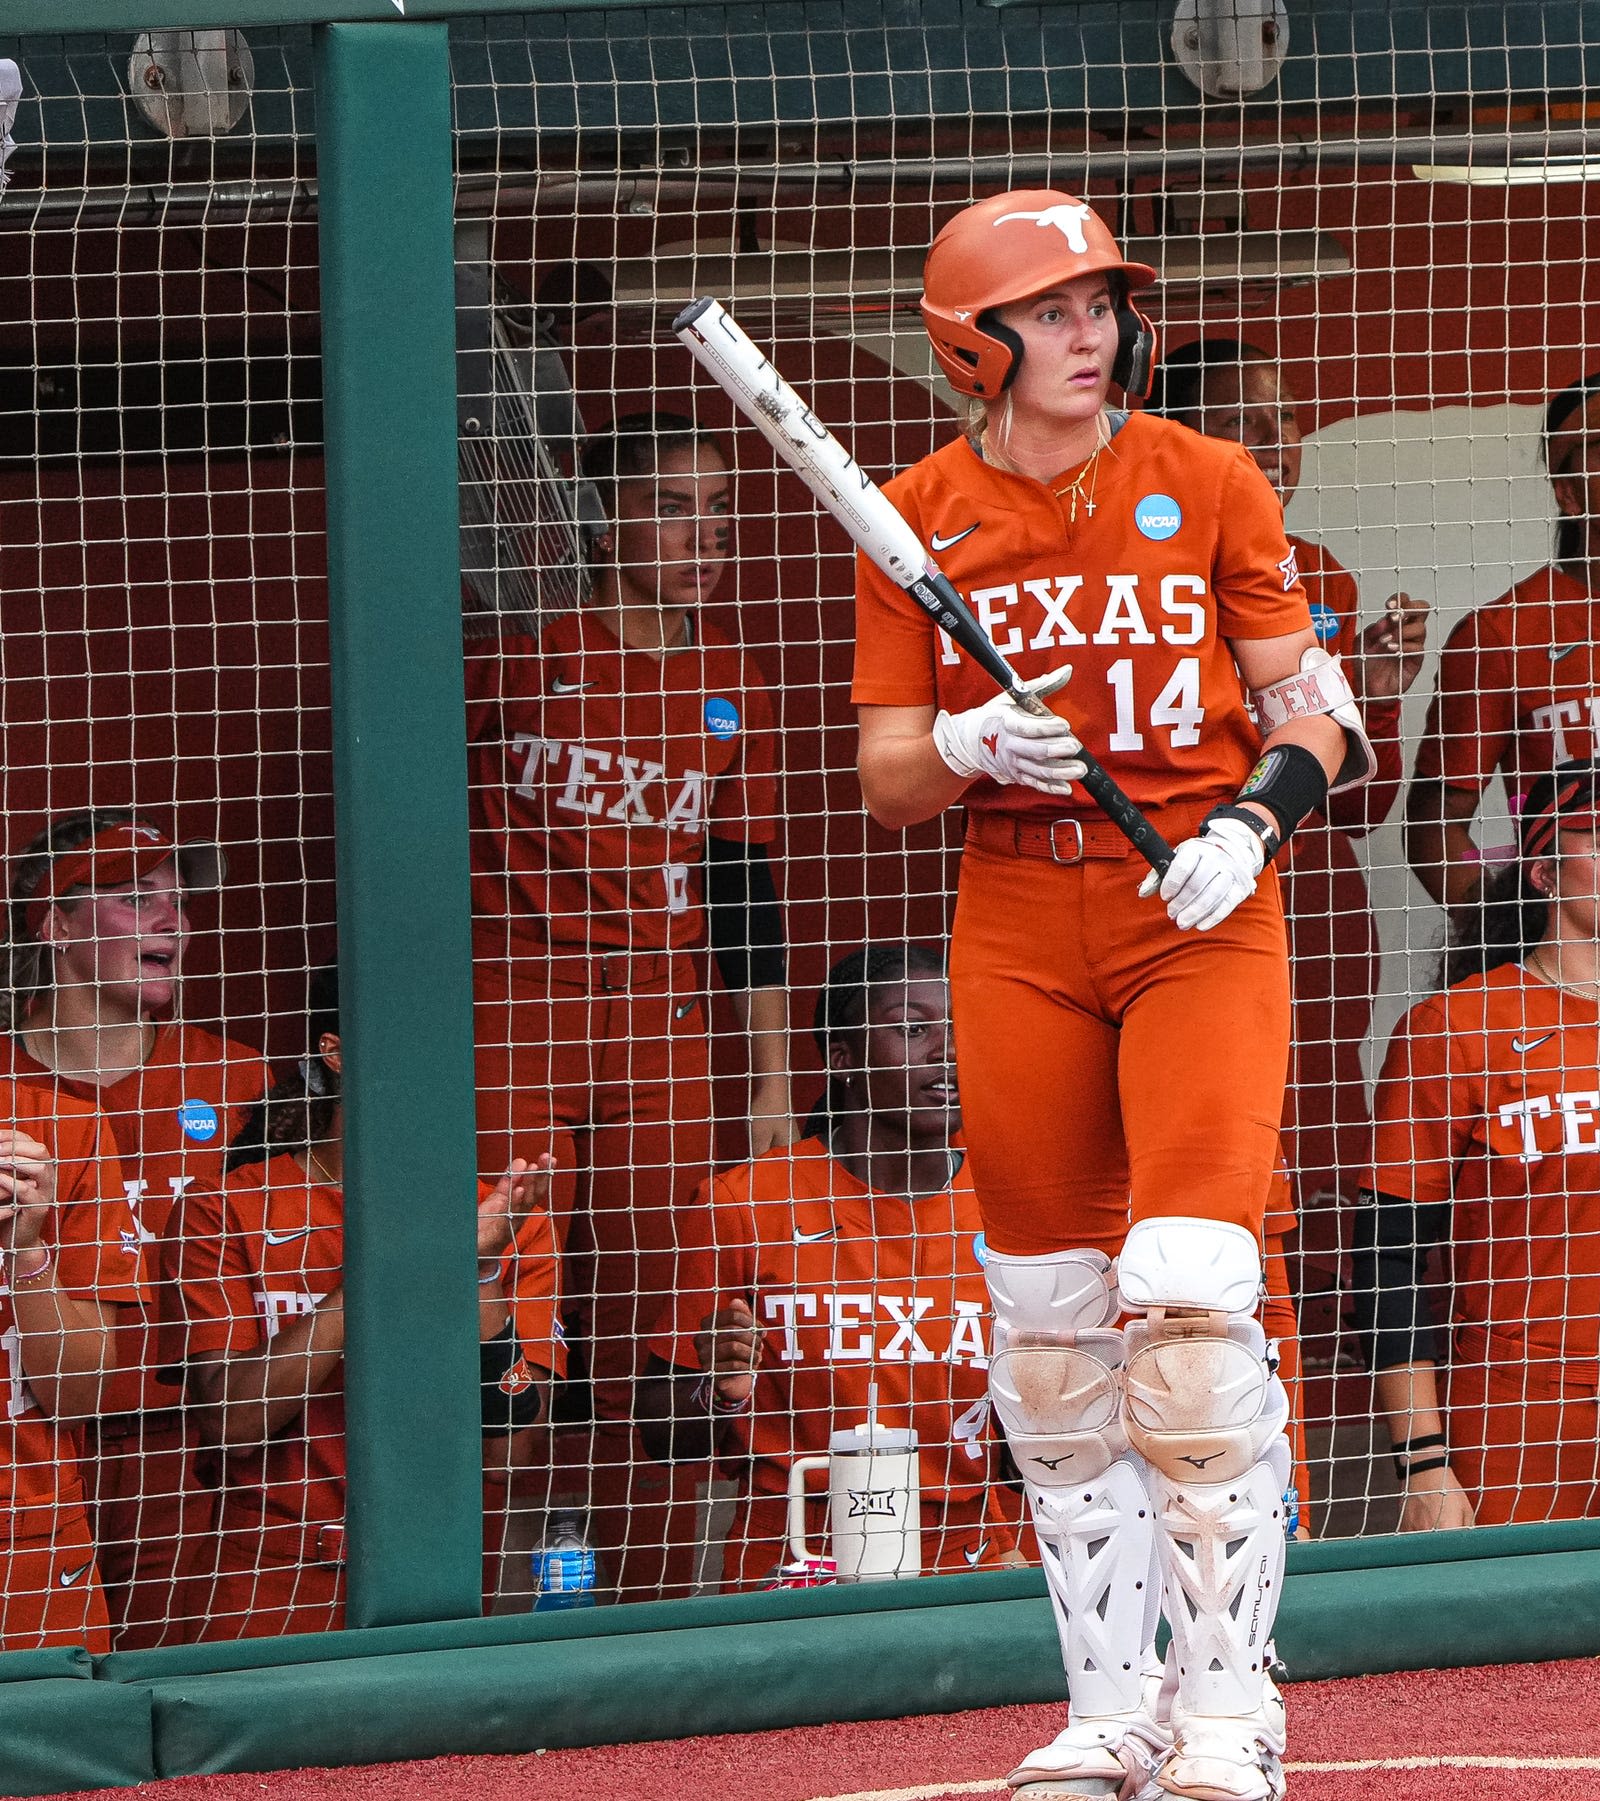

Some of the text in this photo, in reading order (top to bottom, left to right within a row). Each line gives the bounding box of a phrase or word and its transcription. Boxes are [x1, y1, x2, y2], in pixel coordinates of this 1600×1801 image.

[1141, 515, 1178, 528] NCAA
[707, 716, 738, 731] NCAA
[1106, 657, 1206, 752] 14
[511, 731, 716, 834] TEXA
[184, 1119, 217, 1130] NCAA
[764, 1293, 993, 1371] TEXA
[952, 1392, 991, 1460] 4
